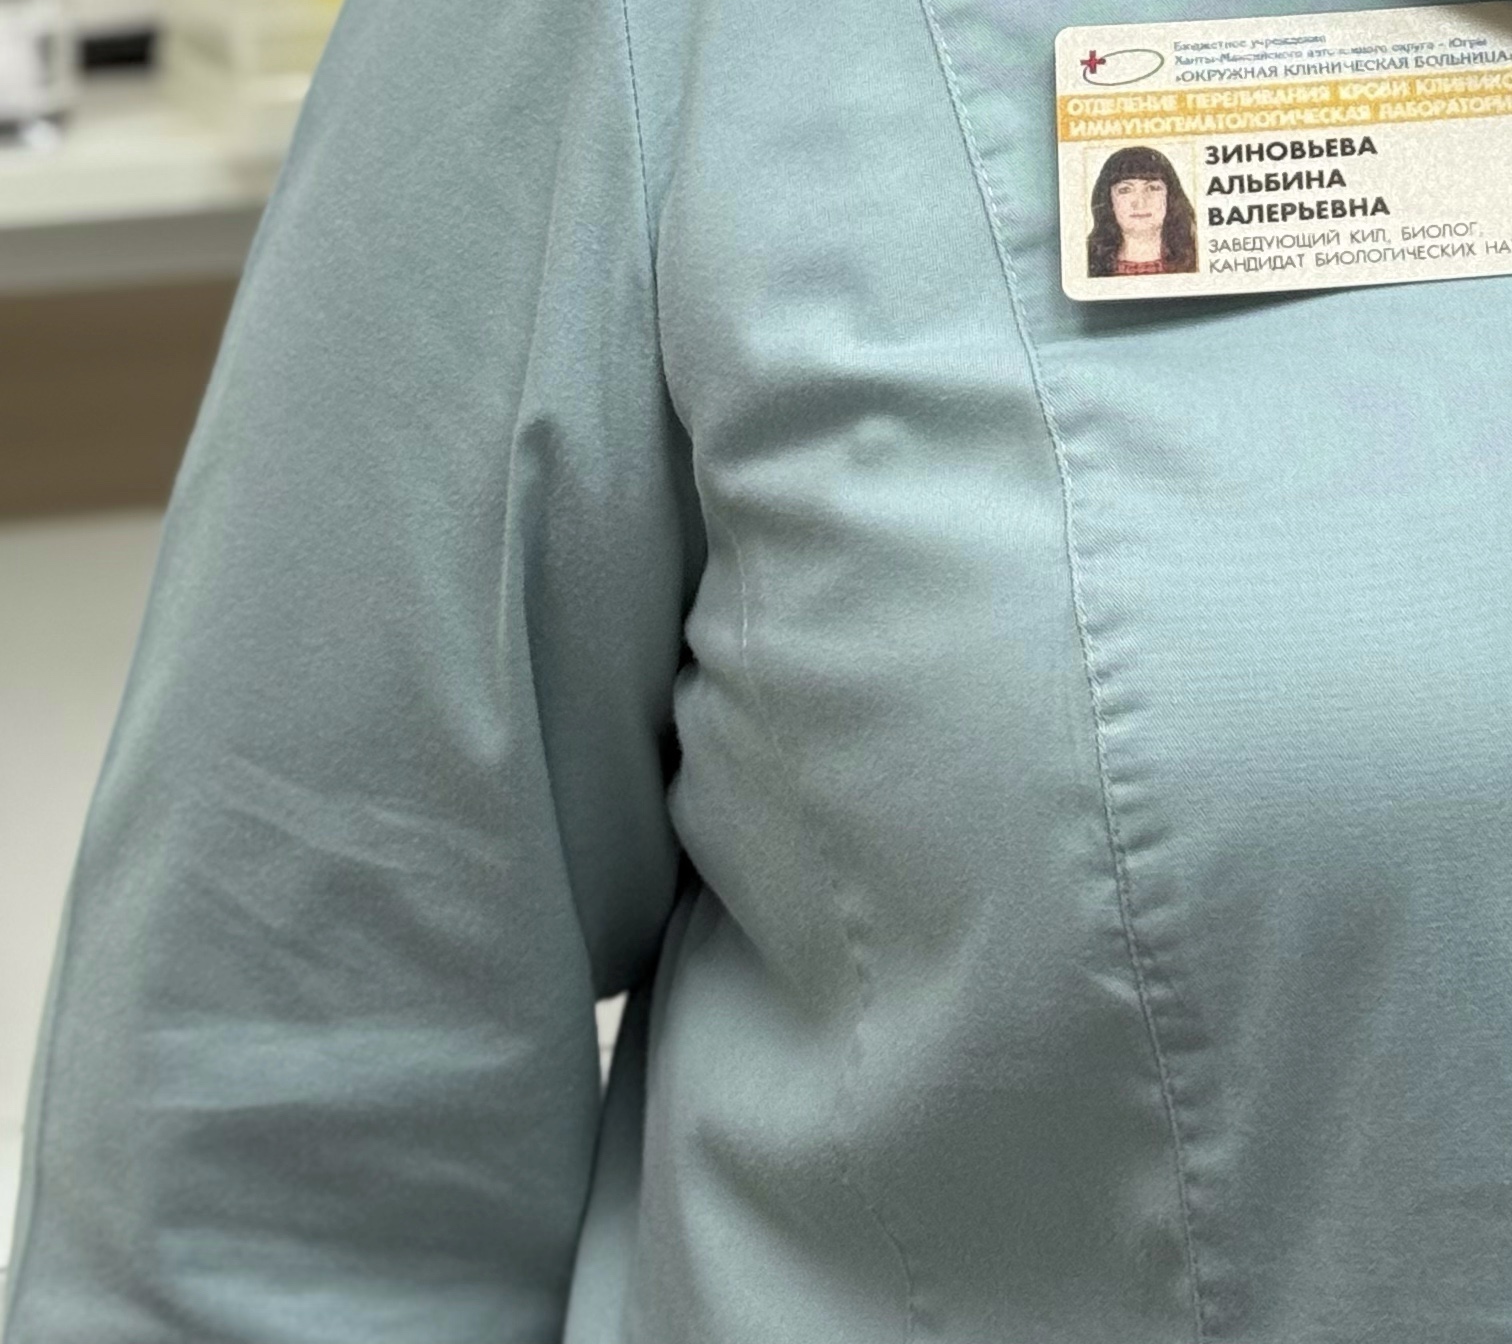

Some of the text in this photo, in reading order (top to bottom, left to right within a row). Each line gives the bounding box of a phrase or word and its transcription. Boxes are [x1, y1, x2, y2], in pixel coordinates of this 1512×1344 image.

[1283, 56, 1410, 76] КЛИНИЧЕСКАЯ
[1066, 93, 1178, 117] ОТДЕЛЕНИЕ
[1185, 84, 1331, 112] ПЕРЕЛИВАНИЯ
[1337, 78, 1411, 102] КРОВИ
[1068, 103, 1372, 138] ИММУНОГЕМАТОЛОГИЧЕСКАЯ
[1204, 135, 1379, 165] ЗИНОВЬЕВА
[1205, 168, 1347, 196] АЛЬБИНА
[1207, 195, 1391, 227] ВАЛЕРЬЕВНА
[1208, 229, 1341, 254] ЗАВЕДУЮЩИЙ
[1208, 252, 1305, 274] КАНДИДАТ
[1314, 241, 1478, 268] БИОЛОГИЧЕСКИХ
